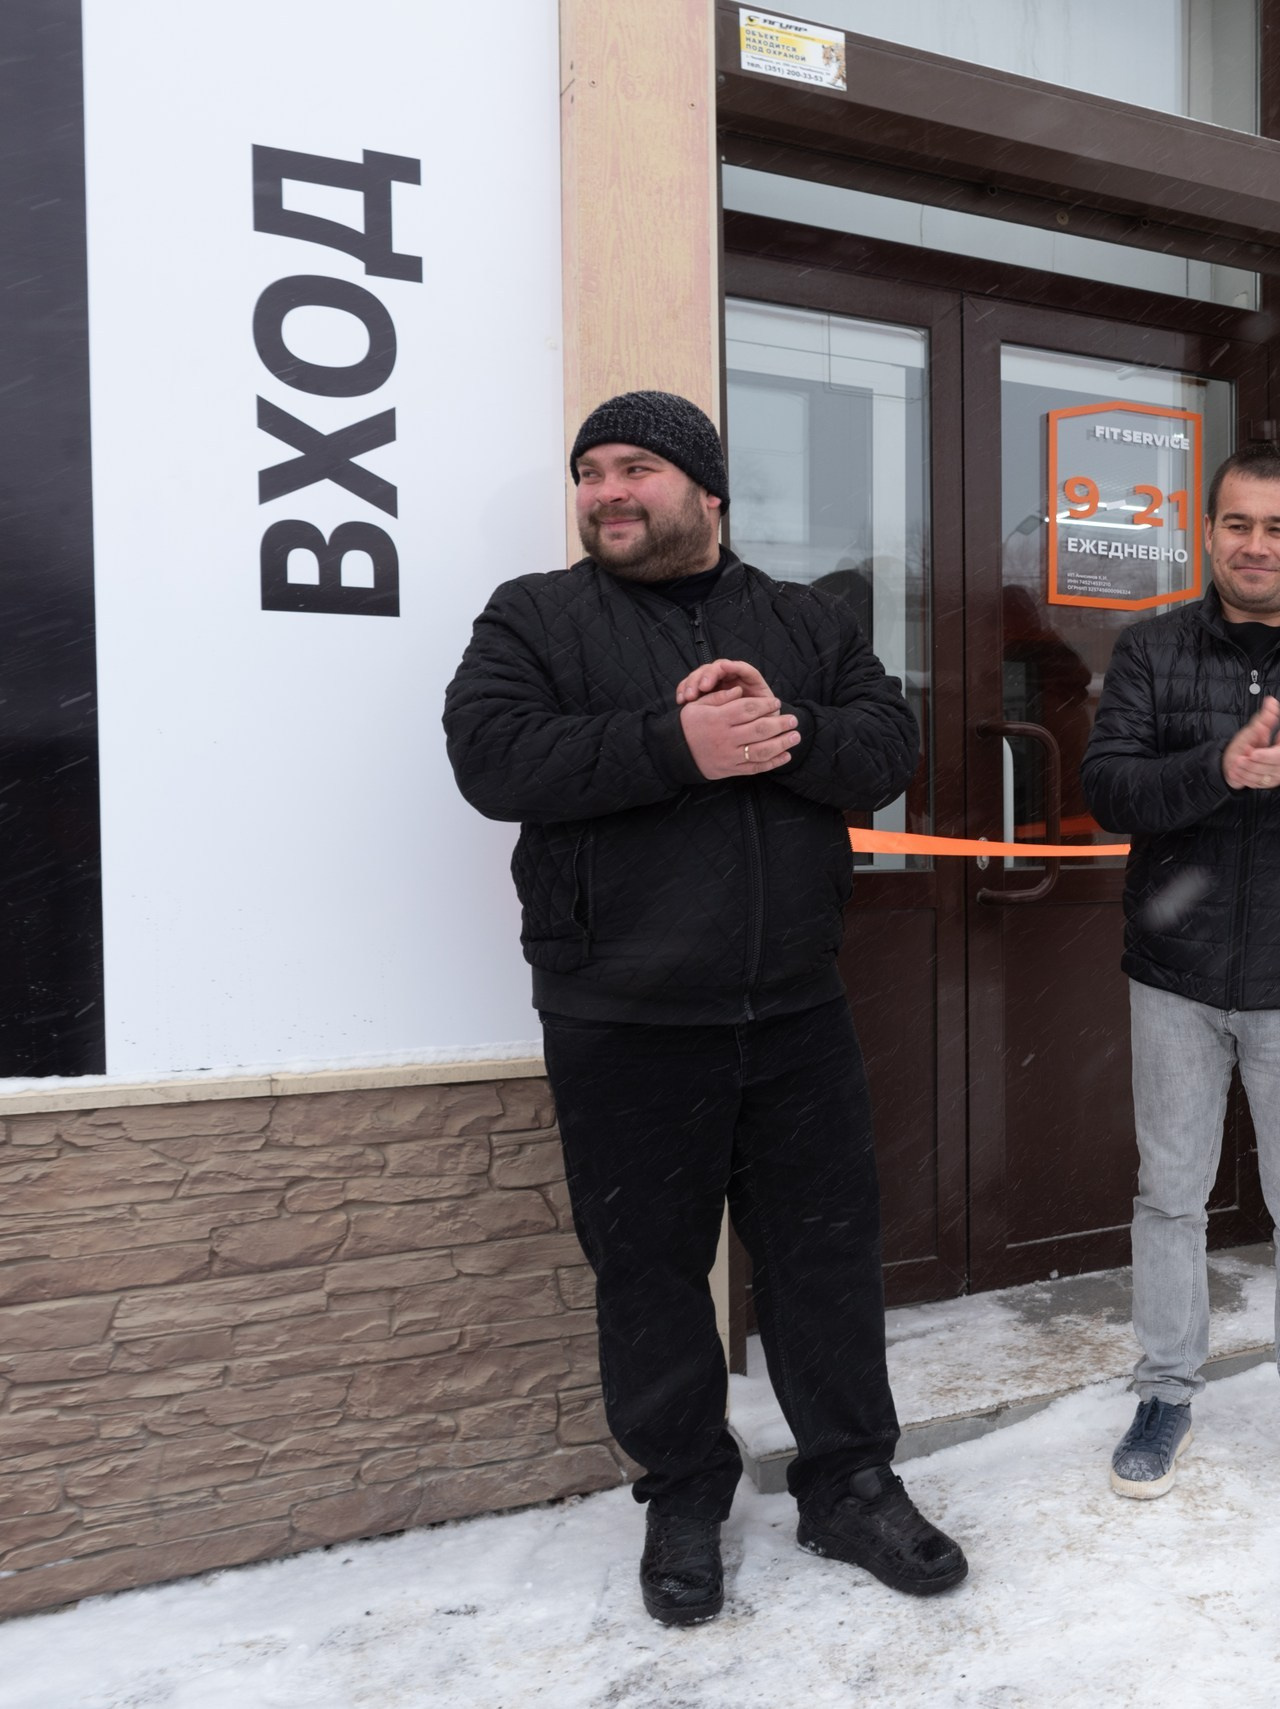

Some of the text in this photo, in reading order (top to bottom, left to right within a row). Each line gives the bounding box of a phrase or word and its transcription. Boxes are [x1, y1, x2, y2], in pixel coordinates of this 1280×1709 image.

[745, 29, 780, 42] ОБЪЕКТ
[745, 37, 797, 52] НАХОДИТСЯ
[745, 43, 764, 53] ПОД
[251, 143, 423, 617] ВХОД
[1064, 476, 1100, 519] 9
[1133, 484, 1188, 531] 21
[1067, 537, 1188, 563] ЕЖЕДНЕВНО
